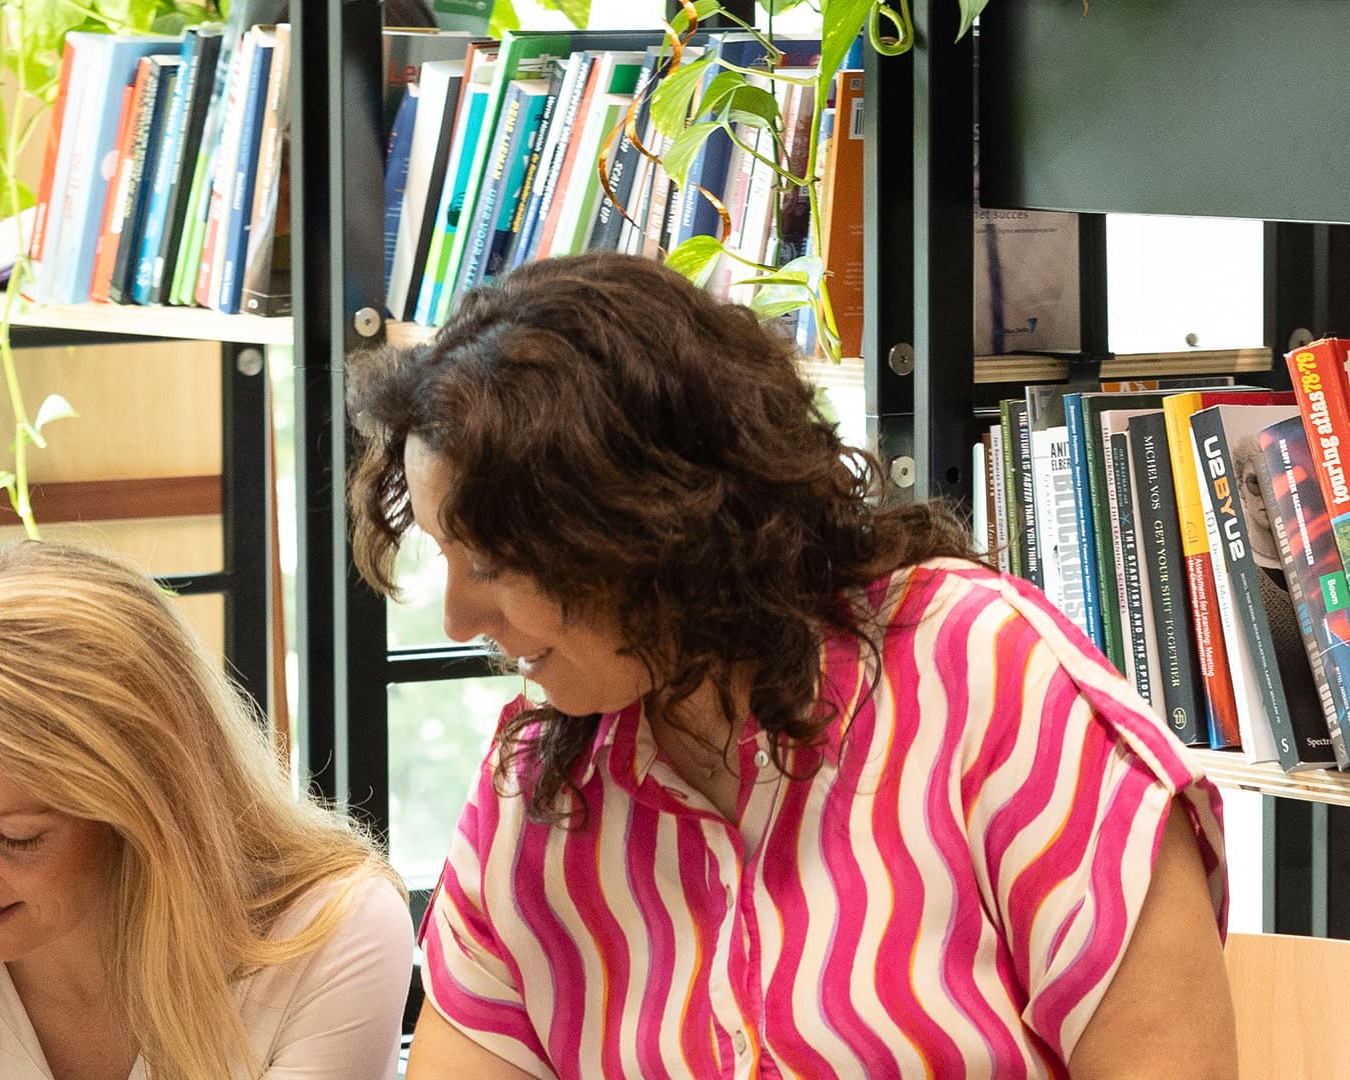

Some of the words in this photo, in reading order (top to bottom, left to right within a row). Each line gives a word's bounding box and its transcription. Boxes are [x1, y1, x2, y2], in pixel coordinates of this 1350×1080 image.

[503, 99, 521, 133] RENS
[542, 95, 555, 119] Verne
[491, 133, 512, 180] LIEMAN
[597, 206, 611, 224] UP
[994, 209, 1028, 219] succes
[472, 222, 489, 253] VOOR
[1018, 411, 1027, 426] THE
[1309, 390, 1333, 435] atlas
[1019, 428, 1029, 459] FUTURE
[1102, 427, 1110, 446] THE
[1021, 460, 1030, 470] IS
[1103, 446, 1114, 485] JOURNAL
[1143, 435, 1158, 484] MICHEL
[1278, 438, 1290, 465] ROLOFF
[1285, 469, 1297, 493] MATEK
[1319, 435, 1350, 506] touring
[1022, 471, 1032, 502] FASTER
[1108, 487, 1116, 501] OF
[1148, 484, 1161, 510] VOS
[1203, 435, 1245, 561] U2BYU2
[1024, 504, 1034, 526] THAN
[1110, 503, 1118, 521] THE
[1204, 509, 1216, 534] 101
[1026, 527, 1035, 544] YOU
[1112, 525, 1123, 569] LEARNING
[1124, 528, 1134, 549] THE
[1152, 520, 1165, 547] GET
[1027, 546, 1037, 572] THINK
[1156, 548, 1169, 582] YOUR
[1117, 572, 1128, 613] SCIENCES
[1127, 554, 1140, 607] STARFISH
[1189, 569, 1199, 604] Challenge
[1193, 558, 1207, 599] Assessment
[1327, 578, 1338, 605] Boom
[1160, 584, 1173, 613] SHIT
[1193, 605, 1201, 617] of
[1198, 600, 1208, 612] for
[1244, 591, 1252, 604] THE
[1133, 612, 1143, 633] AND
[1200, 612, 1212, 646] Learning:
[1136, 638, 1145, 659] THE
[1163, 615, 1181, 687] TOGETHER
[1194, 617, 1208, 675] Implementation
[1204, 646, 1216, 676] Meeting
